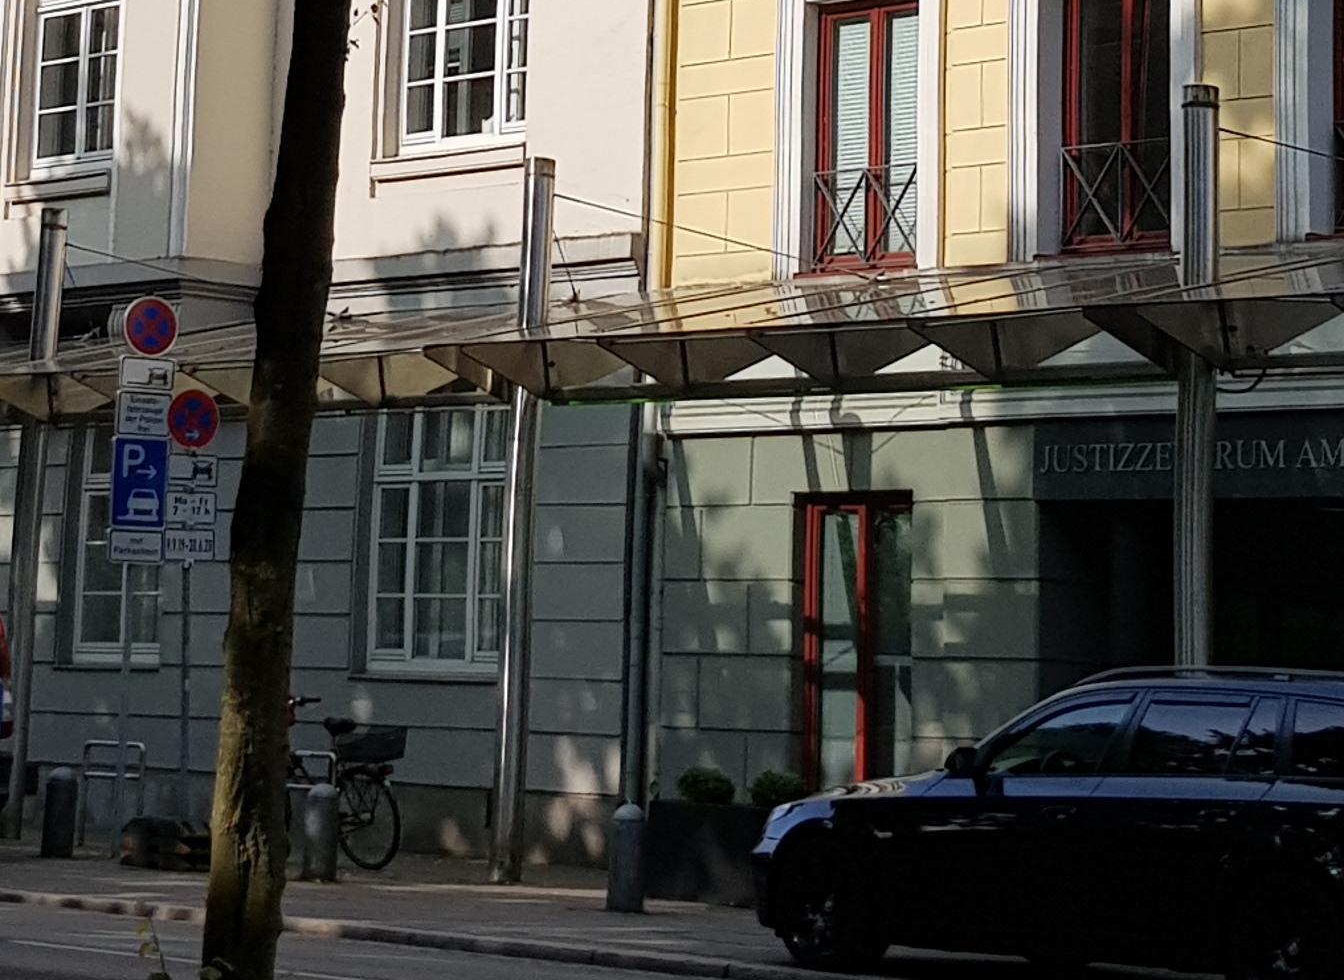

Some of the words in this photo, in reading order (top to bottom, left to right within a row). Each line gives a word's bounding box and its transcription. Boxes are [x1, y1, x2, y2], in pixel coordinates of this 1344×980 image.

[122, 443, 146, 478] P
[1039, 438, 1287, 474] JUSTIZZERUM
[173, 506, 178, 515] 7
[192, 506, 201, 515] 17
[174, 496, 187, 504] Mo
[199, 496, 208, 505] Fr
